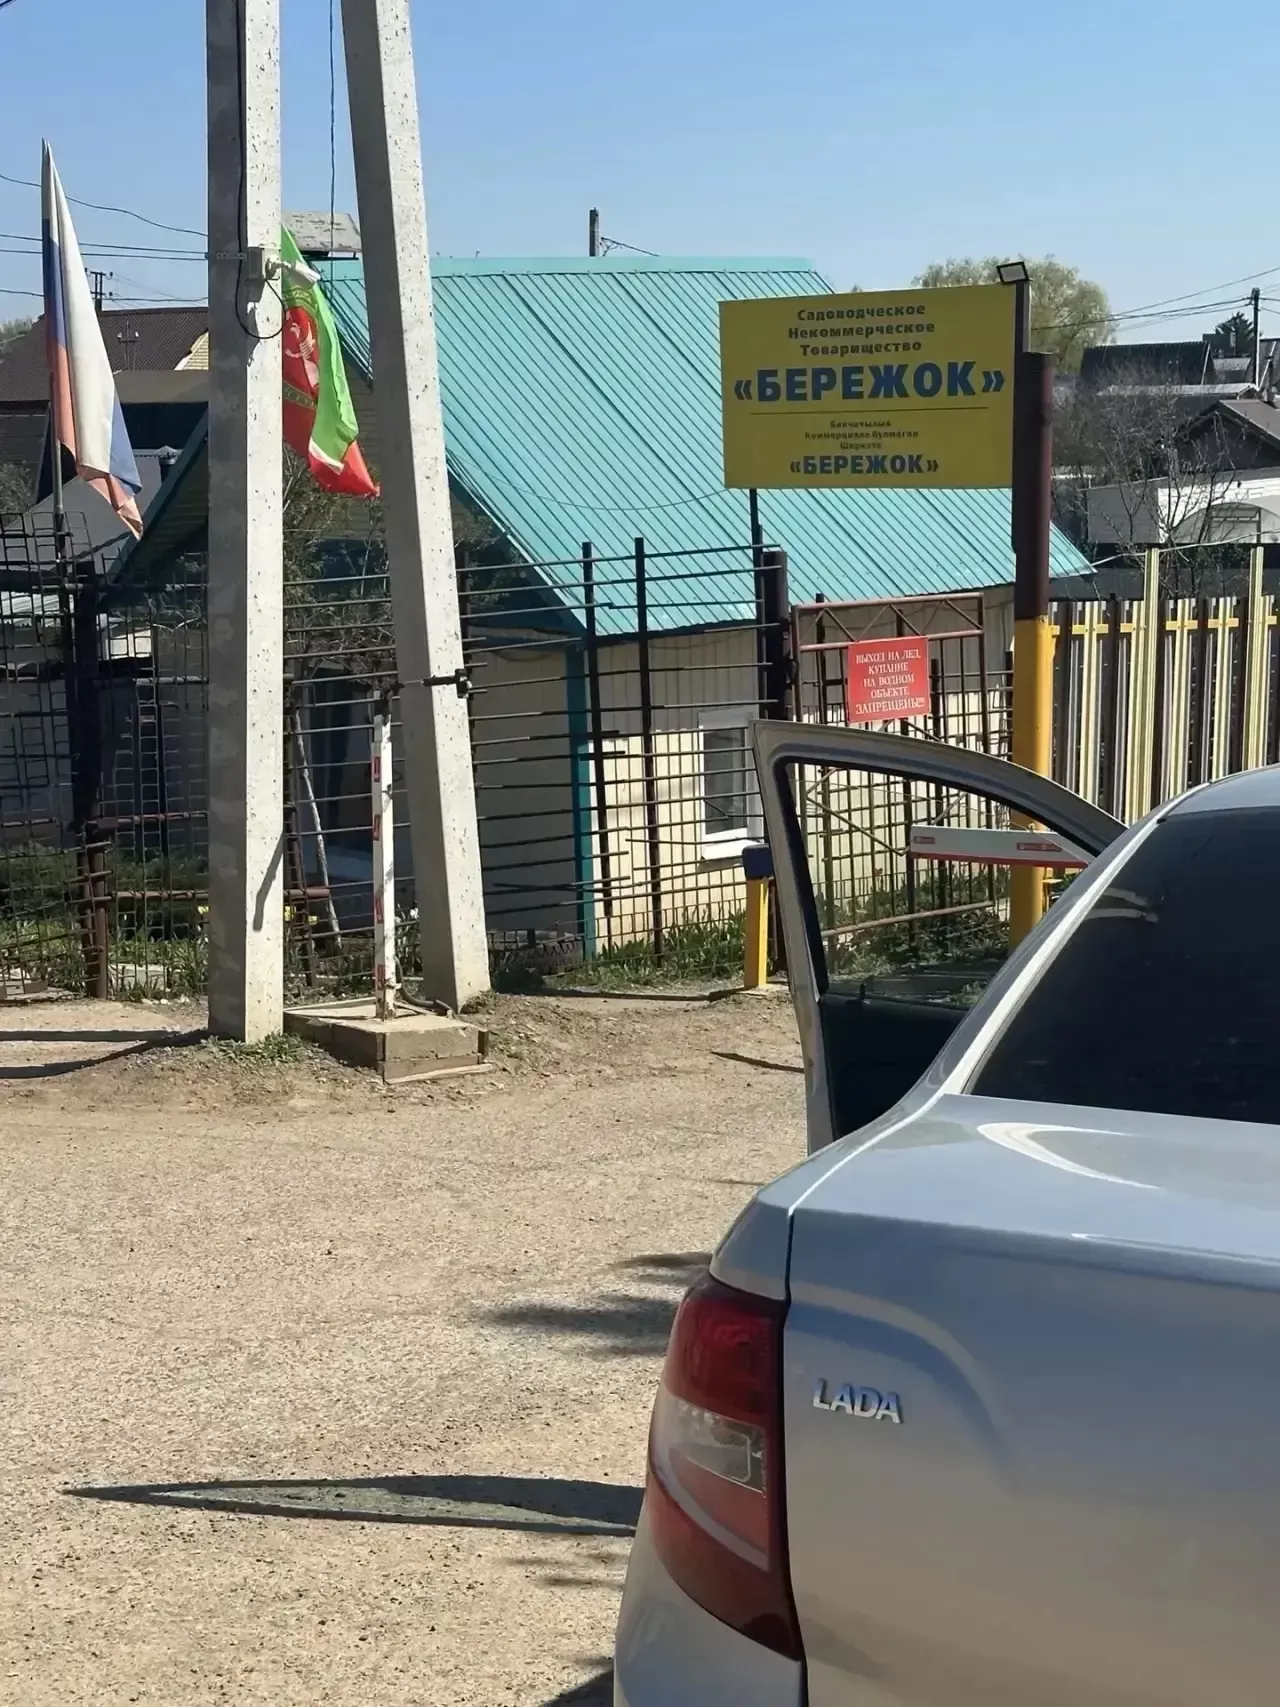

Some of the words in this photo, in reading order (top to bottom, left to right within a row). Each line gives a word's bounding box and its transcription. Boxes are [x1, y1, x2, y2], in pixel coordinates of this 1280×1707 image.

[797, 304, 926, 322] Садоводческое
[788, 322, 935, 339] Некоммерческое
[800, 340, 922, 357] Товарищество
[734, 361, 1006, 403] «БЕРЕЖОК»
[790, 454, 939, 475] «БЕРЕЖОК»
[856, 652, 885, 664] ВЫХОД
[888, 650, 900, 661] НА
[868, 662, 909, 675] КУПАНИЕ
[863, 678, 876, 687] НА
[879, 673, 914, 686] ВОДНОМ
[870, 686, 910, 699] ОБЪЕКТЕ
[812, 1378, 903, 1424] LADA
